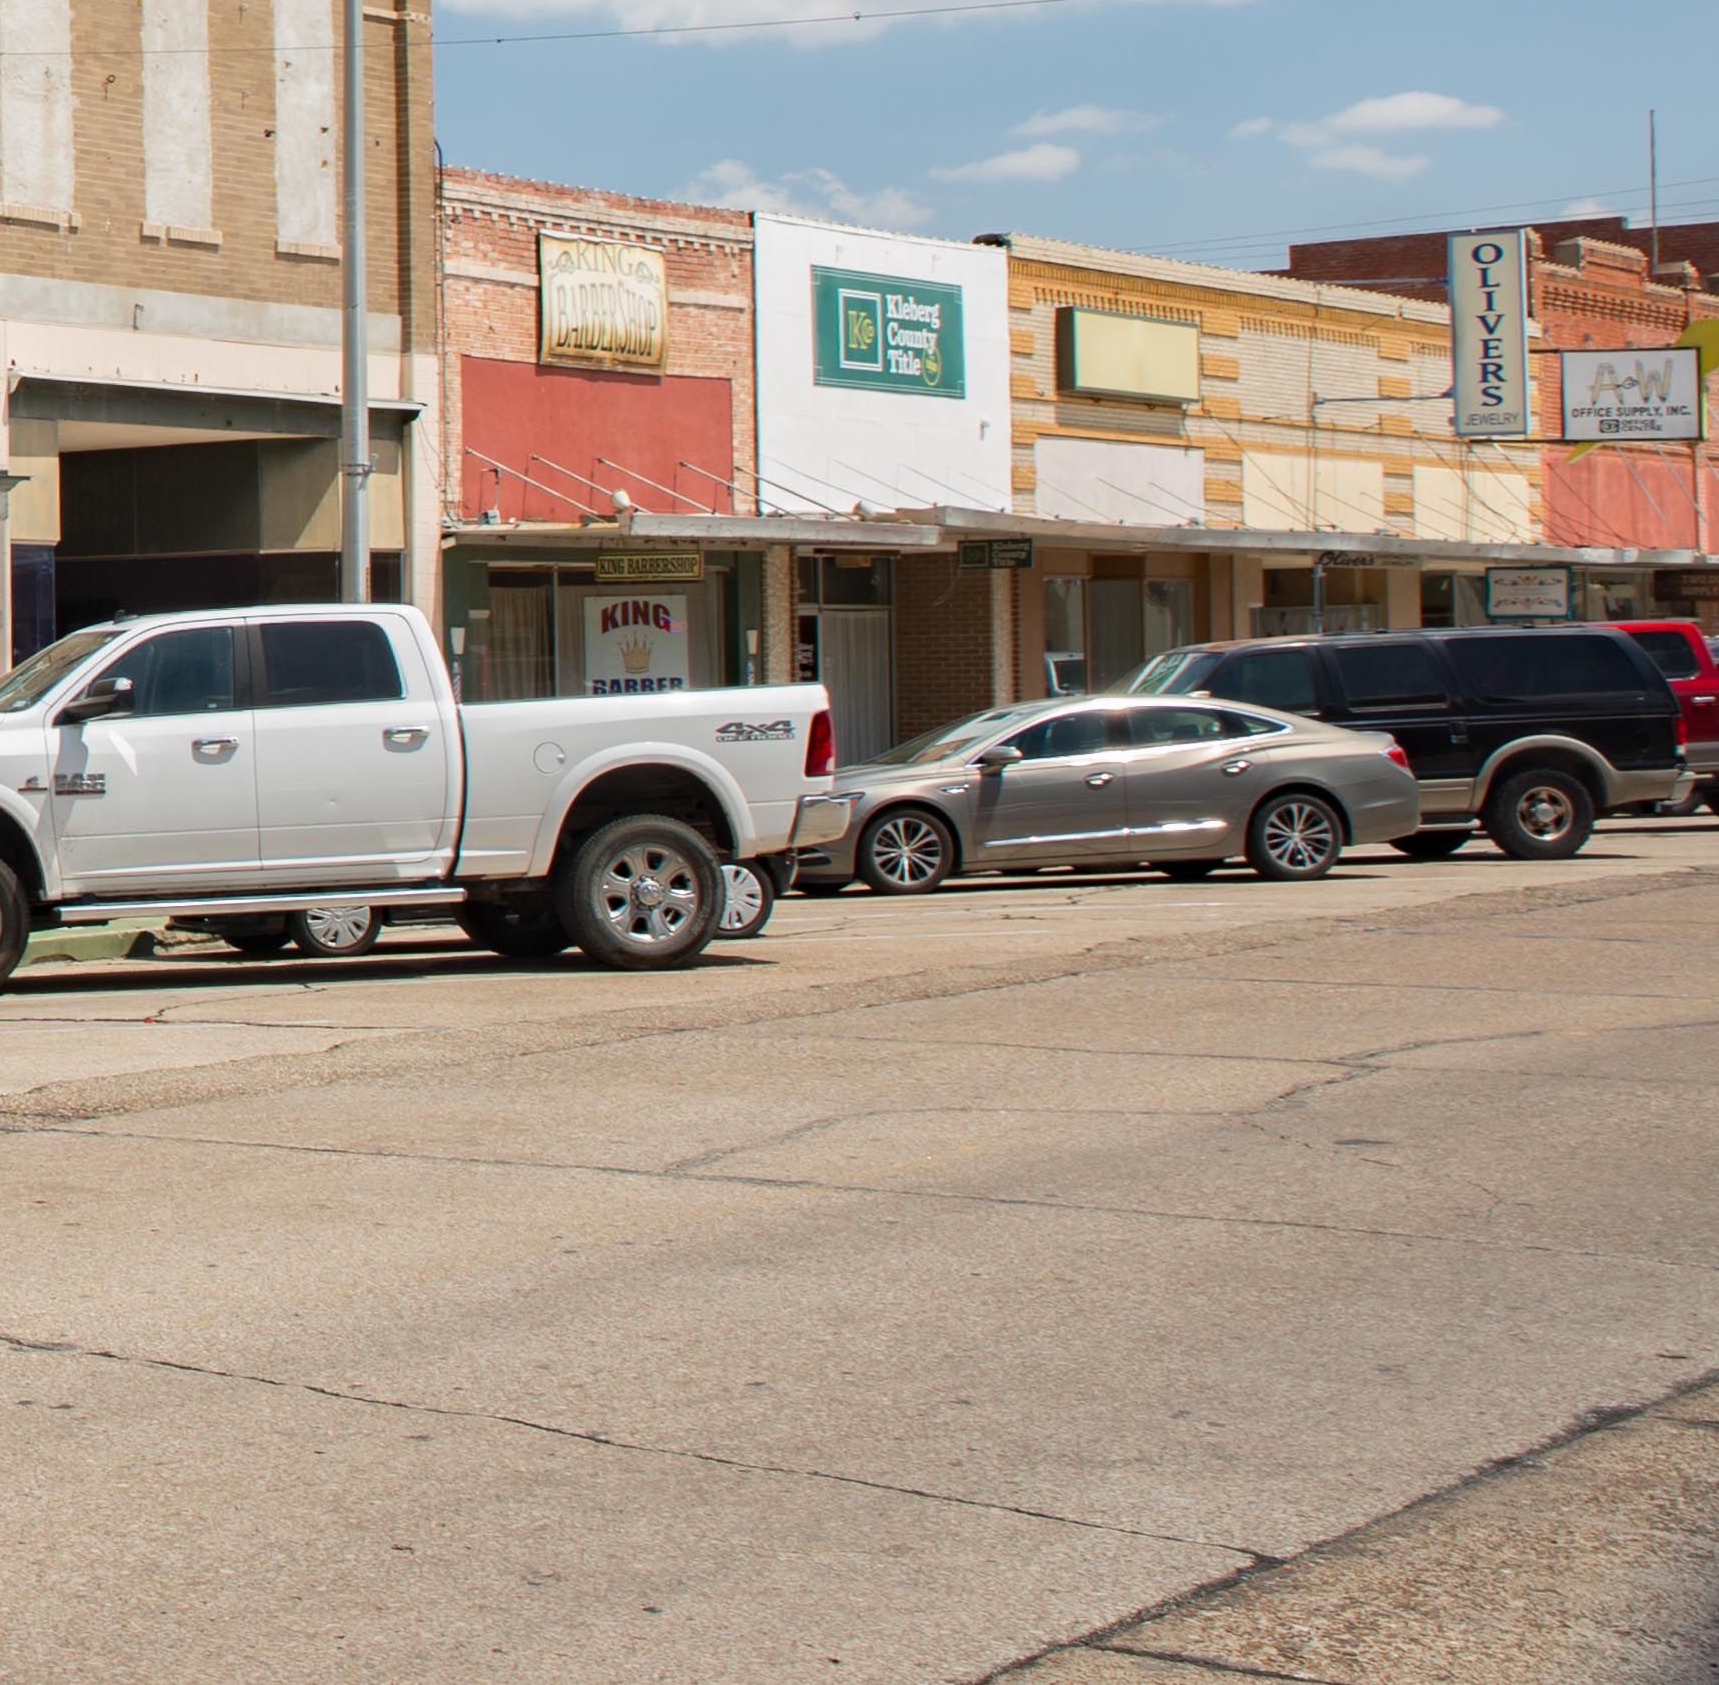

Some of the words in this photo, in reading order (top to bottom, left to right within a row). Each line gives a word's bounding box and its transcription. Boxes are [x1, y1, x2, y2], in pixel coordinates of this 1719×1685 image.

[576, 242, 633, 275] KING
[556, 279, 657, 356] BARBERSHOP
[885, 294, 940, 328] Kleberg
[1472, 243, 1506, 407] OLIVERS
[887, 322, 937, 354] County
[887, 349, 921, 375] Title
[1465, 412, 1518, 426] JEWELRY
[1571, 407, 1613, 418] OFFICE
[1616, 406, 1663, 417] SUPPLY,
[1666, 405, 1692, 416] INC.
[599, 559, 625, 574] KING
[627, 557, 697, 574] BARBERSHOP
[601, 600, 671, 634] KING
